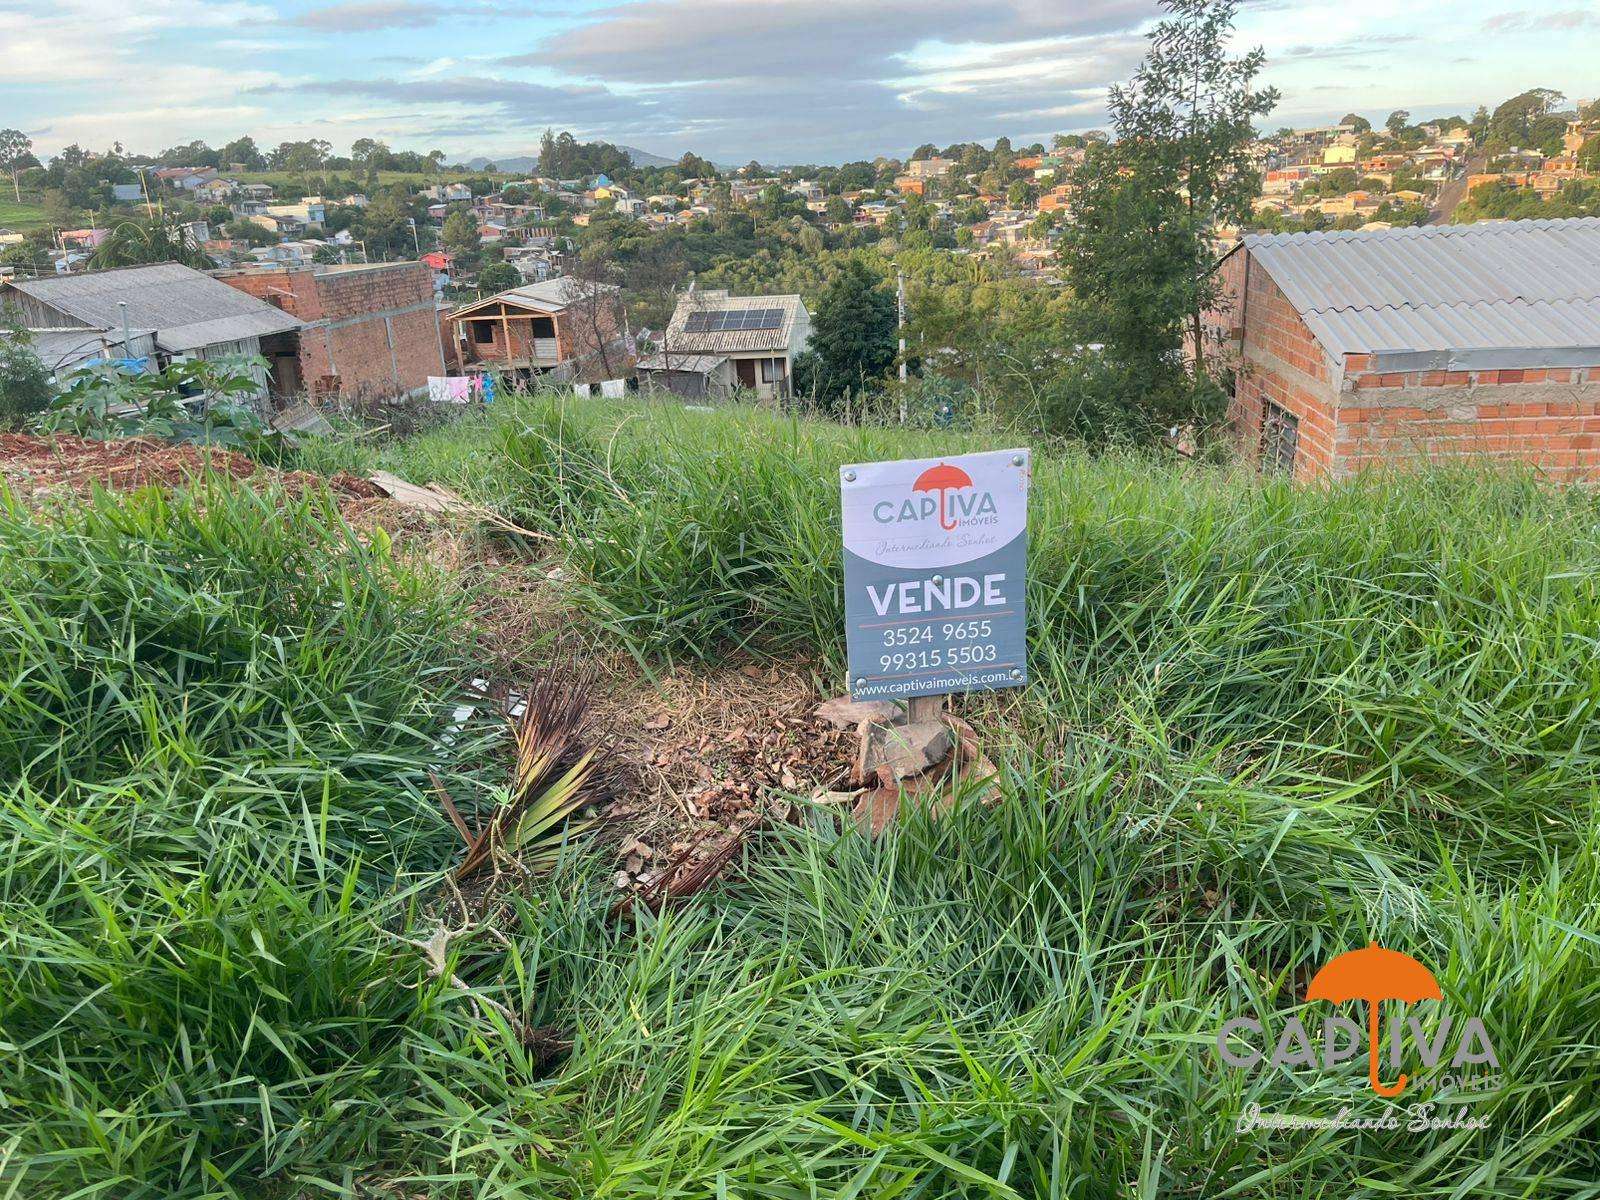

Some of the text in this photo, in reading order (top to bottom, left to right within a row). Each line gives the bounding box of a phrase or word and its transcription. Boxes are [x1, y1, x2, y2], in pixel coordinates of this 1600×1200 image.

[873, 492, 998, 526] CAPTIVA
[866, 573, 1006, 616] VENDE
[883, 620, 992, 647] 3524 9655
[879, 645, 996, 672] 99315 5503
